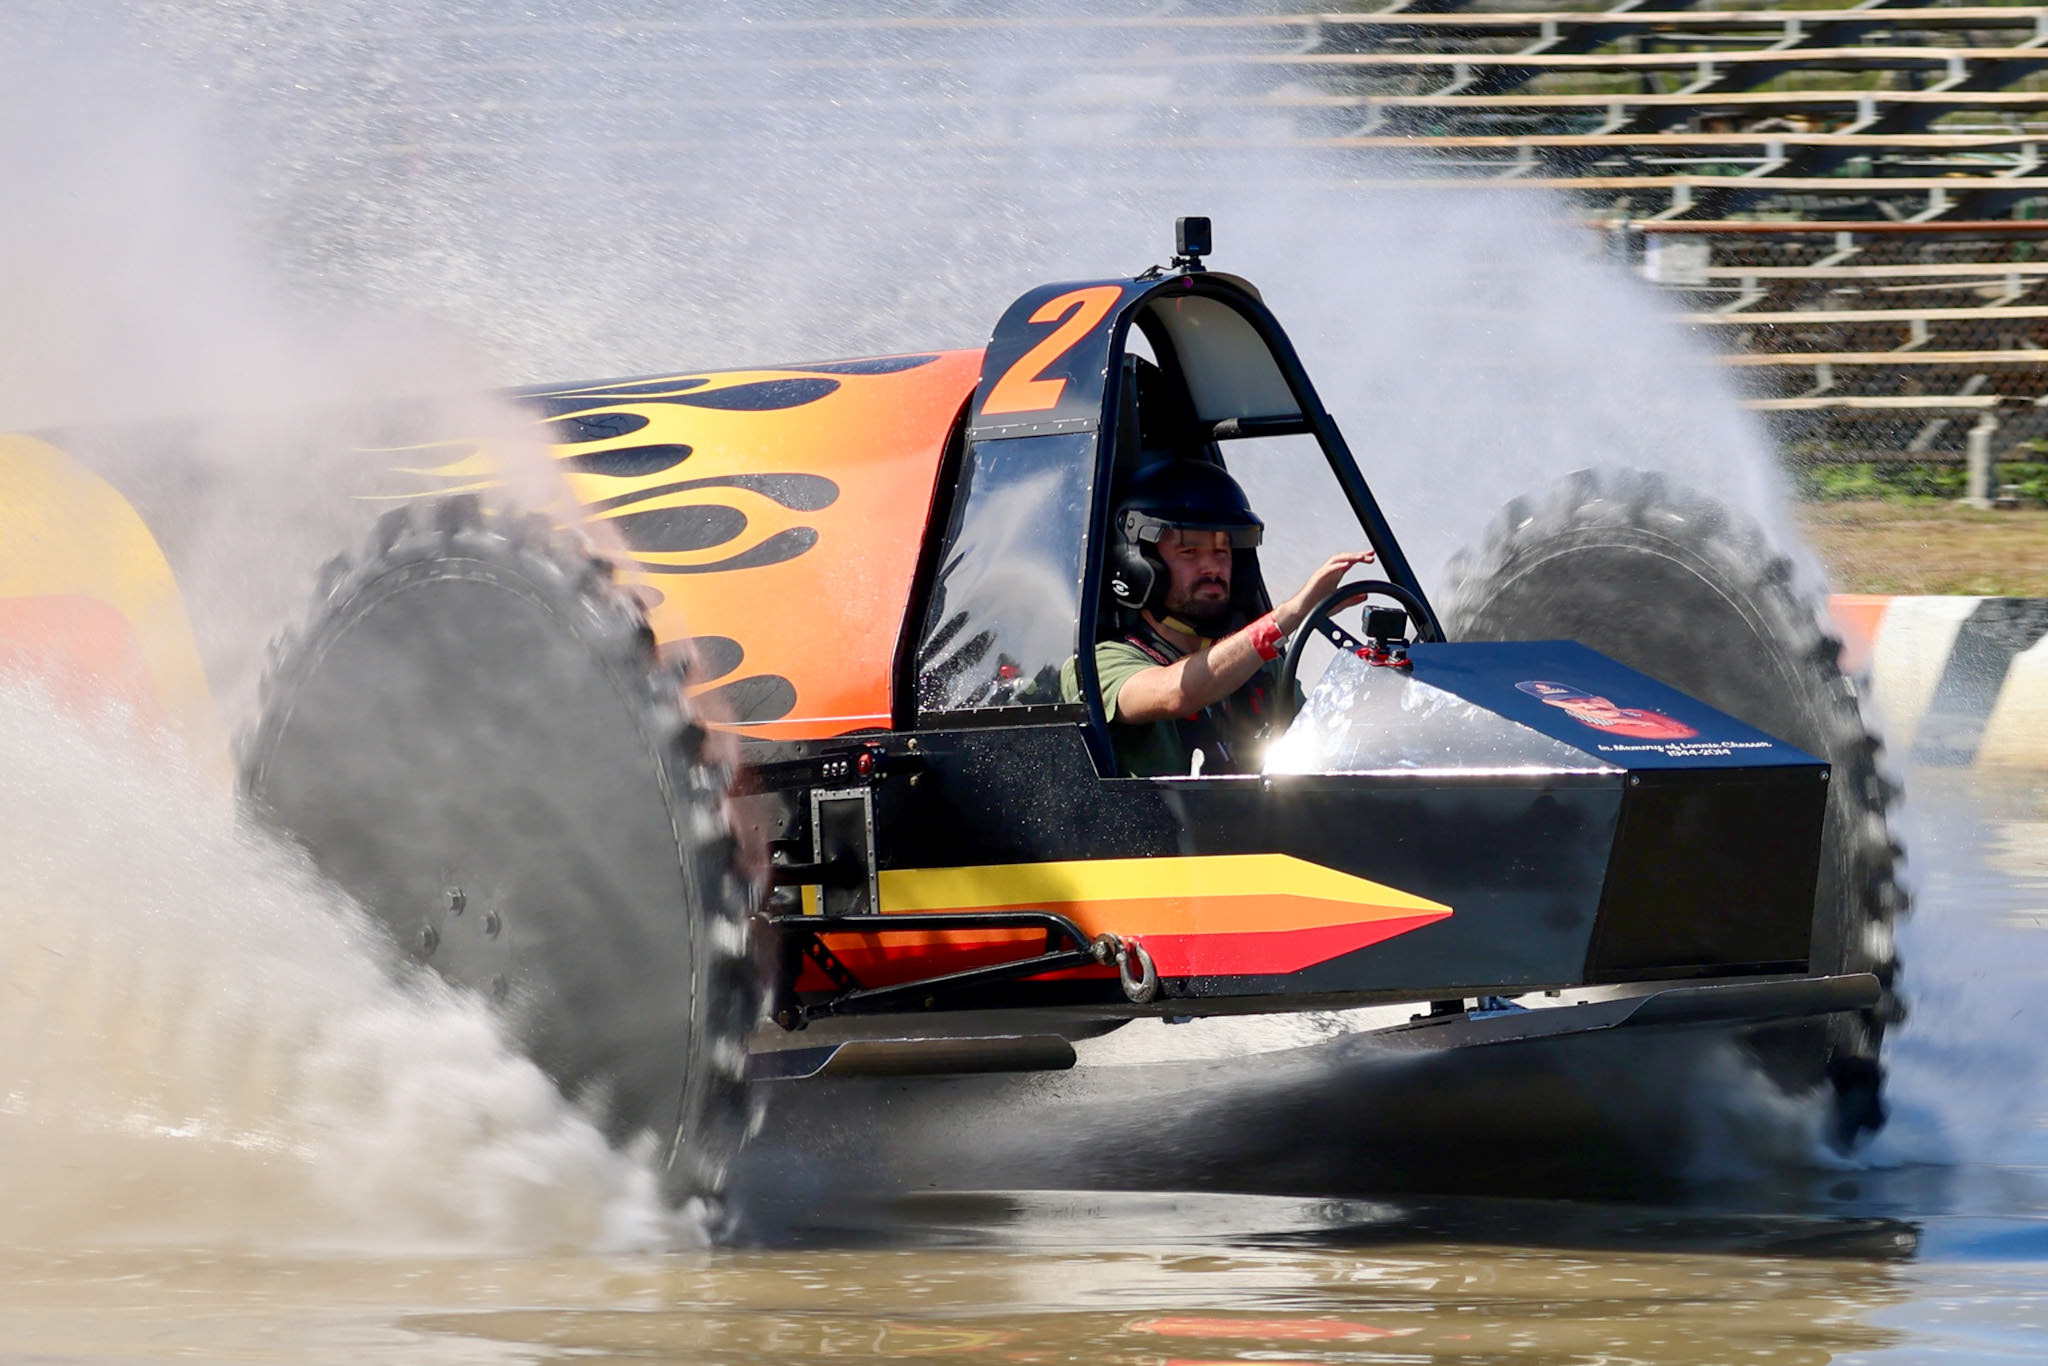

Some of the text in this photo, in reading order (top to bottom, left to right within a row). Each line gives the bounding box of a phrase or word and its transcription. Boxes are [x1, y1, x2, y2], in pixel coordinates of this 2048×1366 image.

[980, 285, 1124, 416] 2
[1598, 744, 1613, 752] In
[1613, 744, 1664, 752] Memory
[1665, 743, 1681, 752] of
[1680, 742, 1721, 750] Lonnie
[1666, 749, 1731, 757] 1944-2014
